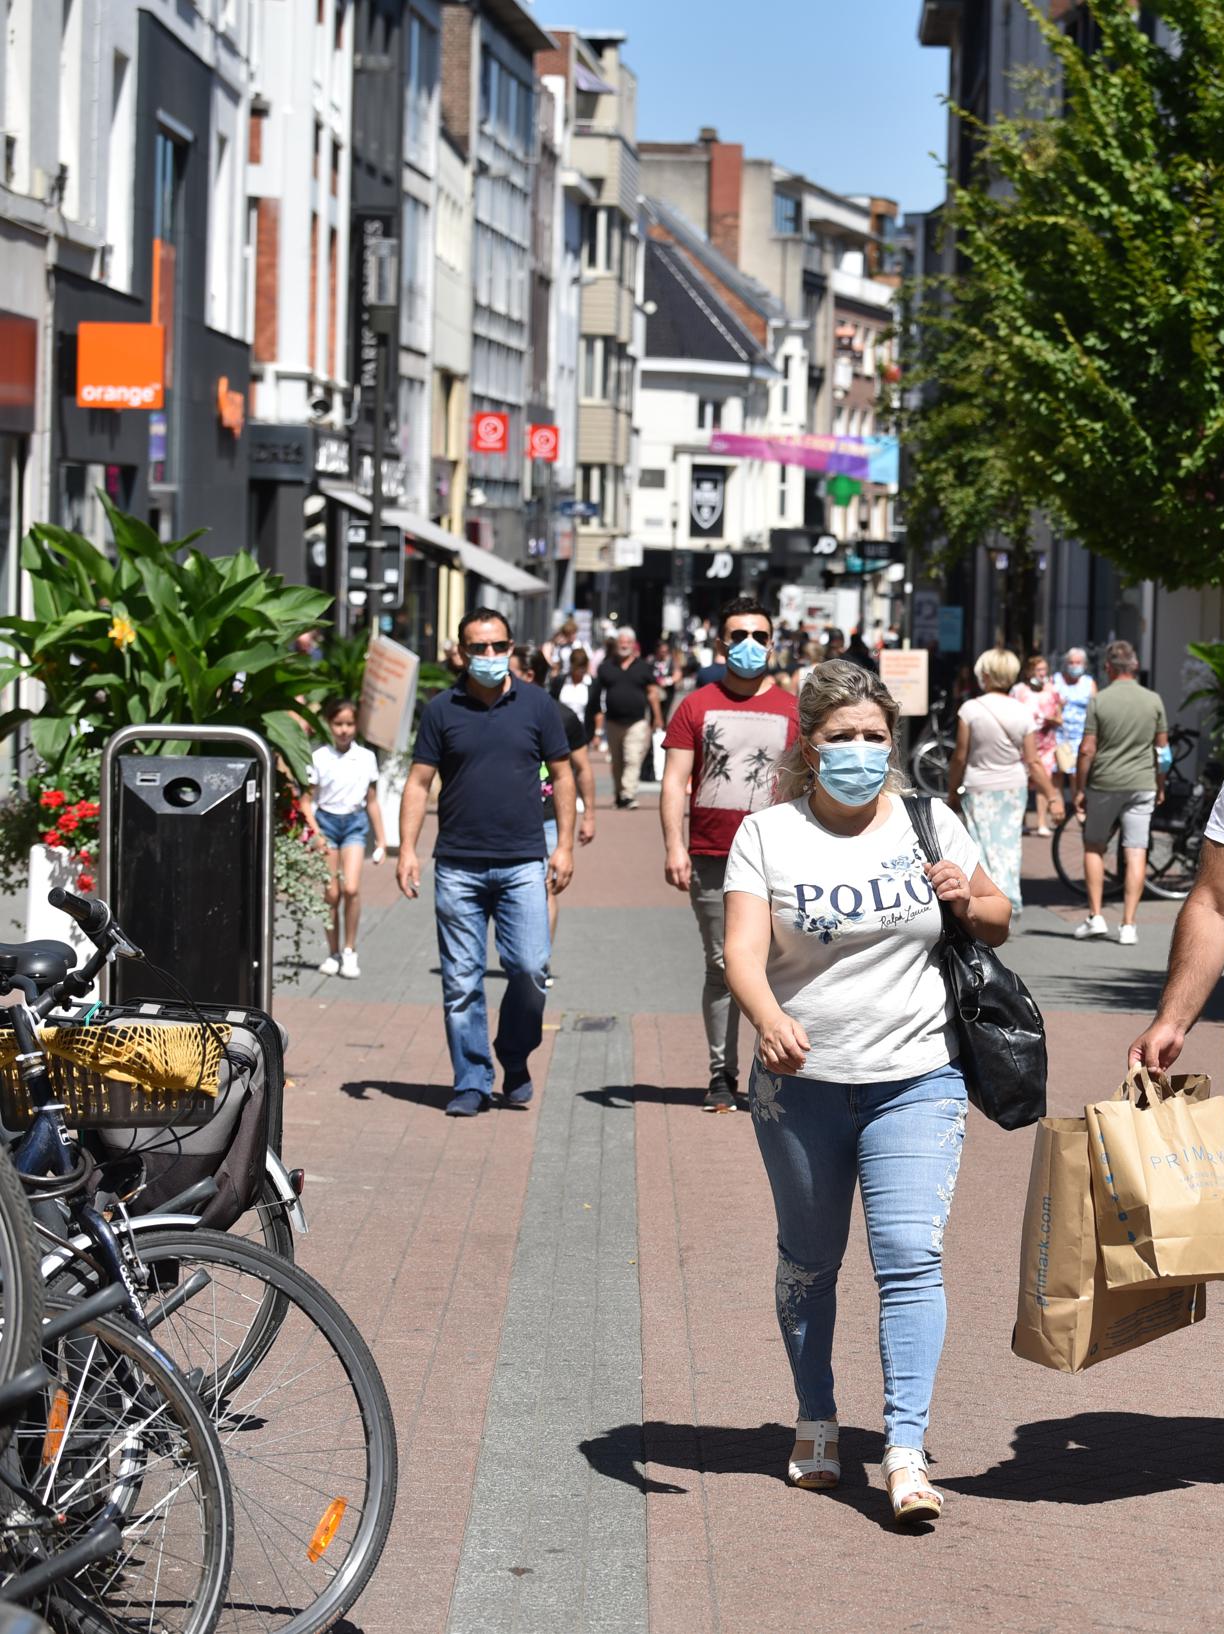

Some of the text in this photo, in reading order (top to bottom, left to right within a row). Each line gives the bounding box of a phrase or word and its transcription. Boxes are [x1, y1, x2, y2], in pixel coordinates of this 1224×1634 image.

[82, 384, 156, 407] orange
[706, 553, 733, 579] JD
[794, 875, 933, 918] POLO
[879, 905, 932, 929] Ralph Lauren
[1036, 1195, 1052, 1307] primark.com
